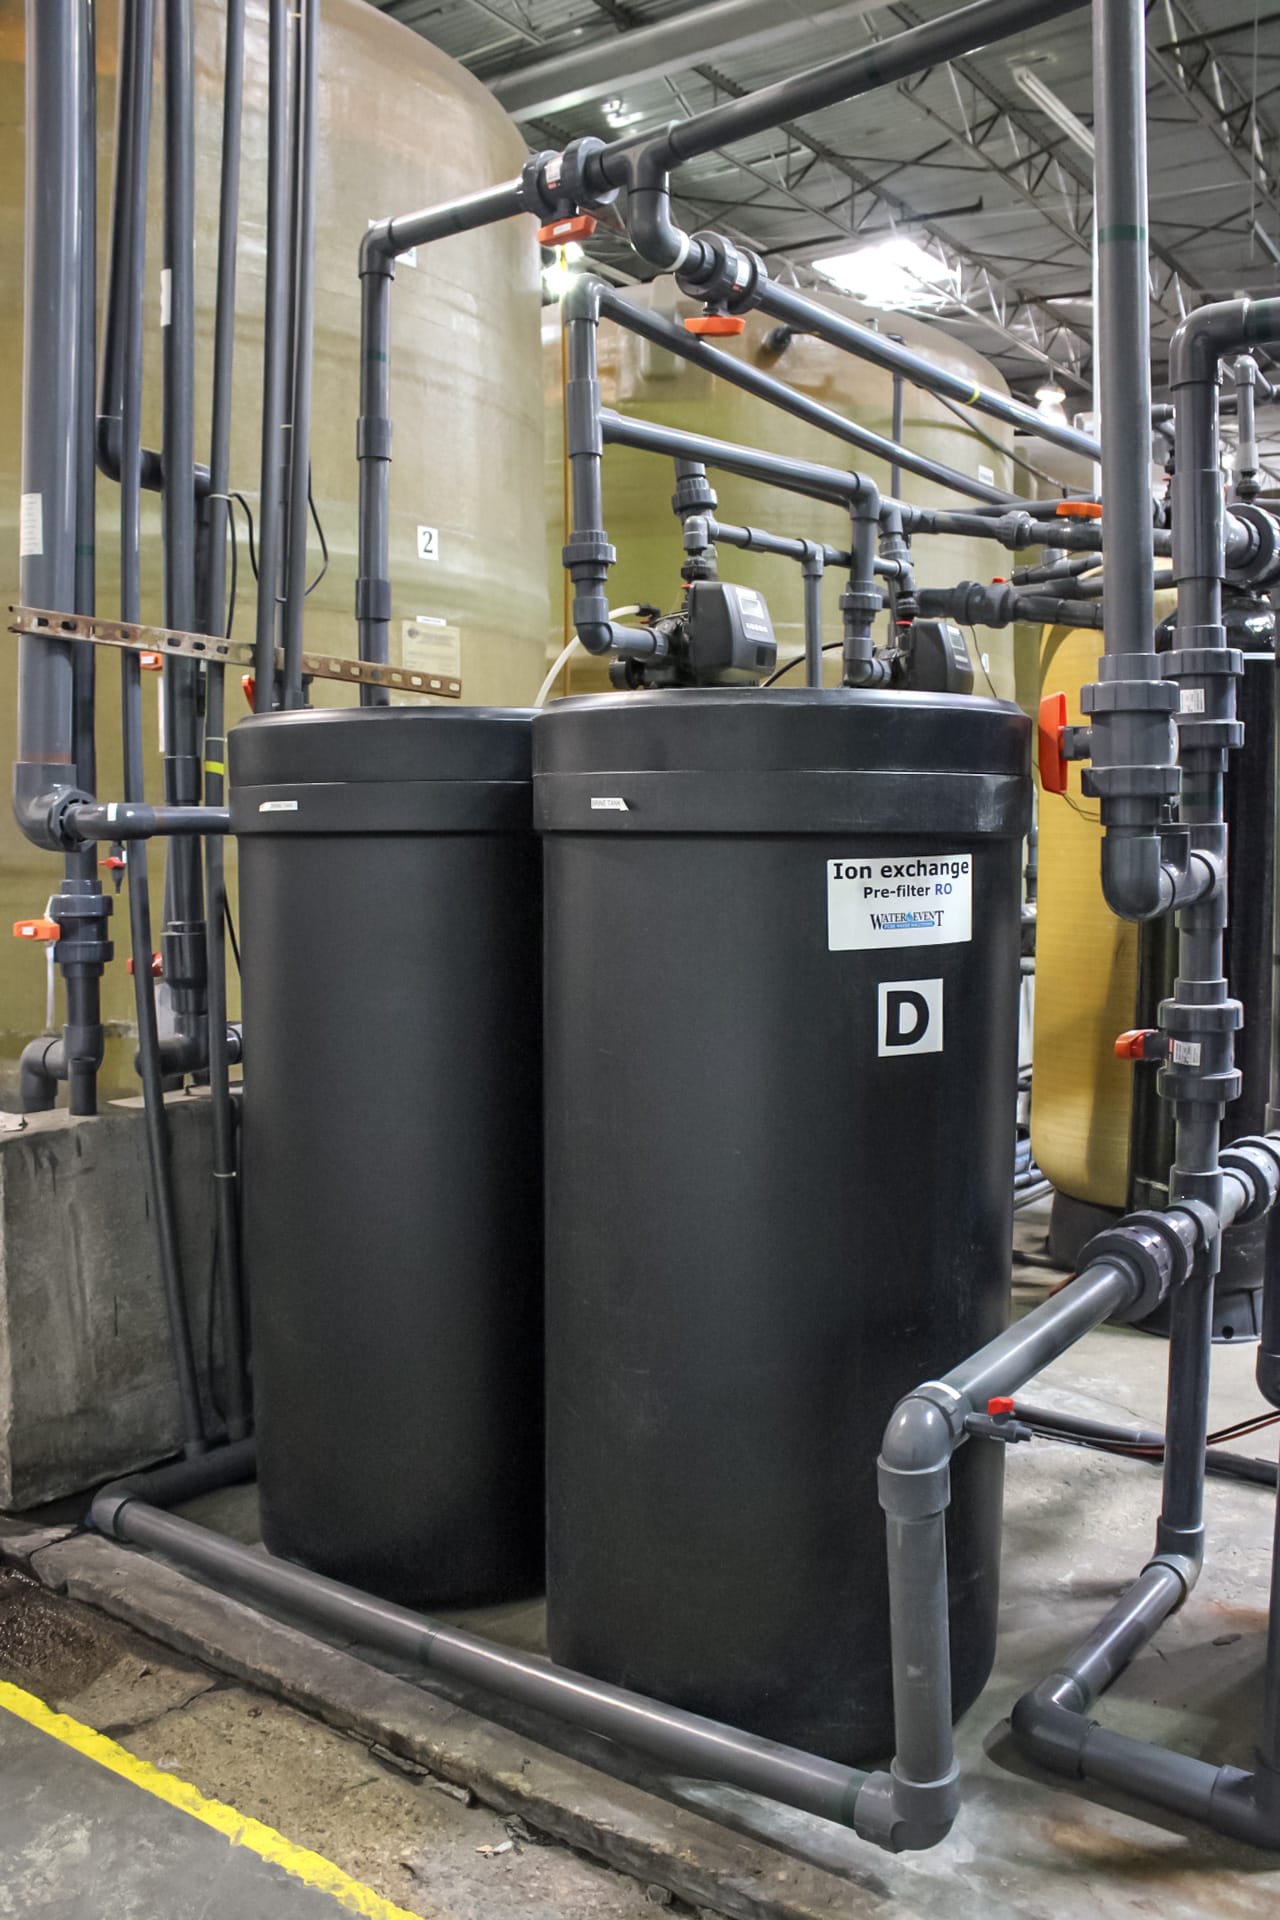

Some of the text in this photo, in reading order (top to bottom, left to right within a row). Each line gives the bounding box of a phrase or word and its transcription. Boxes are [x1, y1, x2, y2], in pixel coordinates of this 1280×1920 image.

[422, 530, 433, 554] 2
[833, 860, 969, 880] Ion exchange
[863, 883, 953, 899] Pre-filter RO
[870, 910, 945, 930] WATER EVENT
[885, 990, 930, 1047] D
